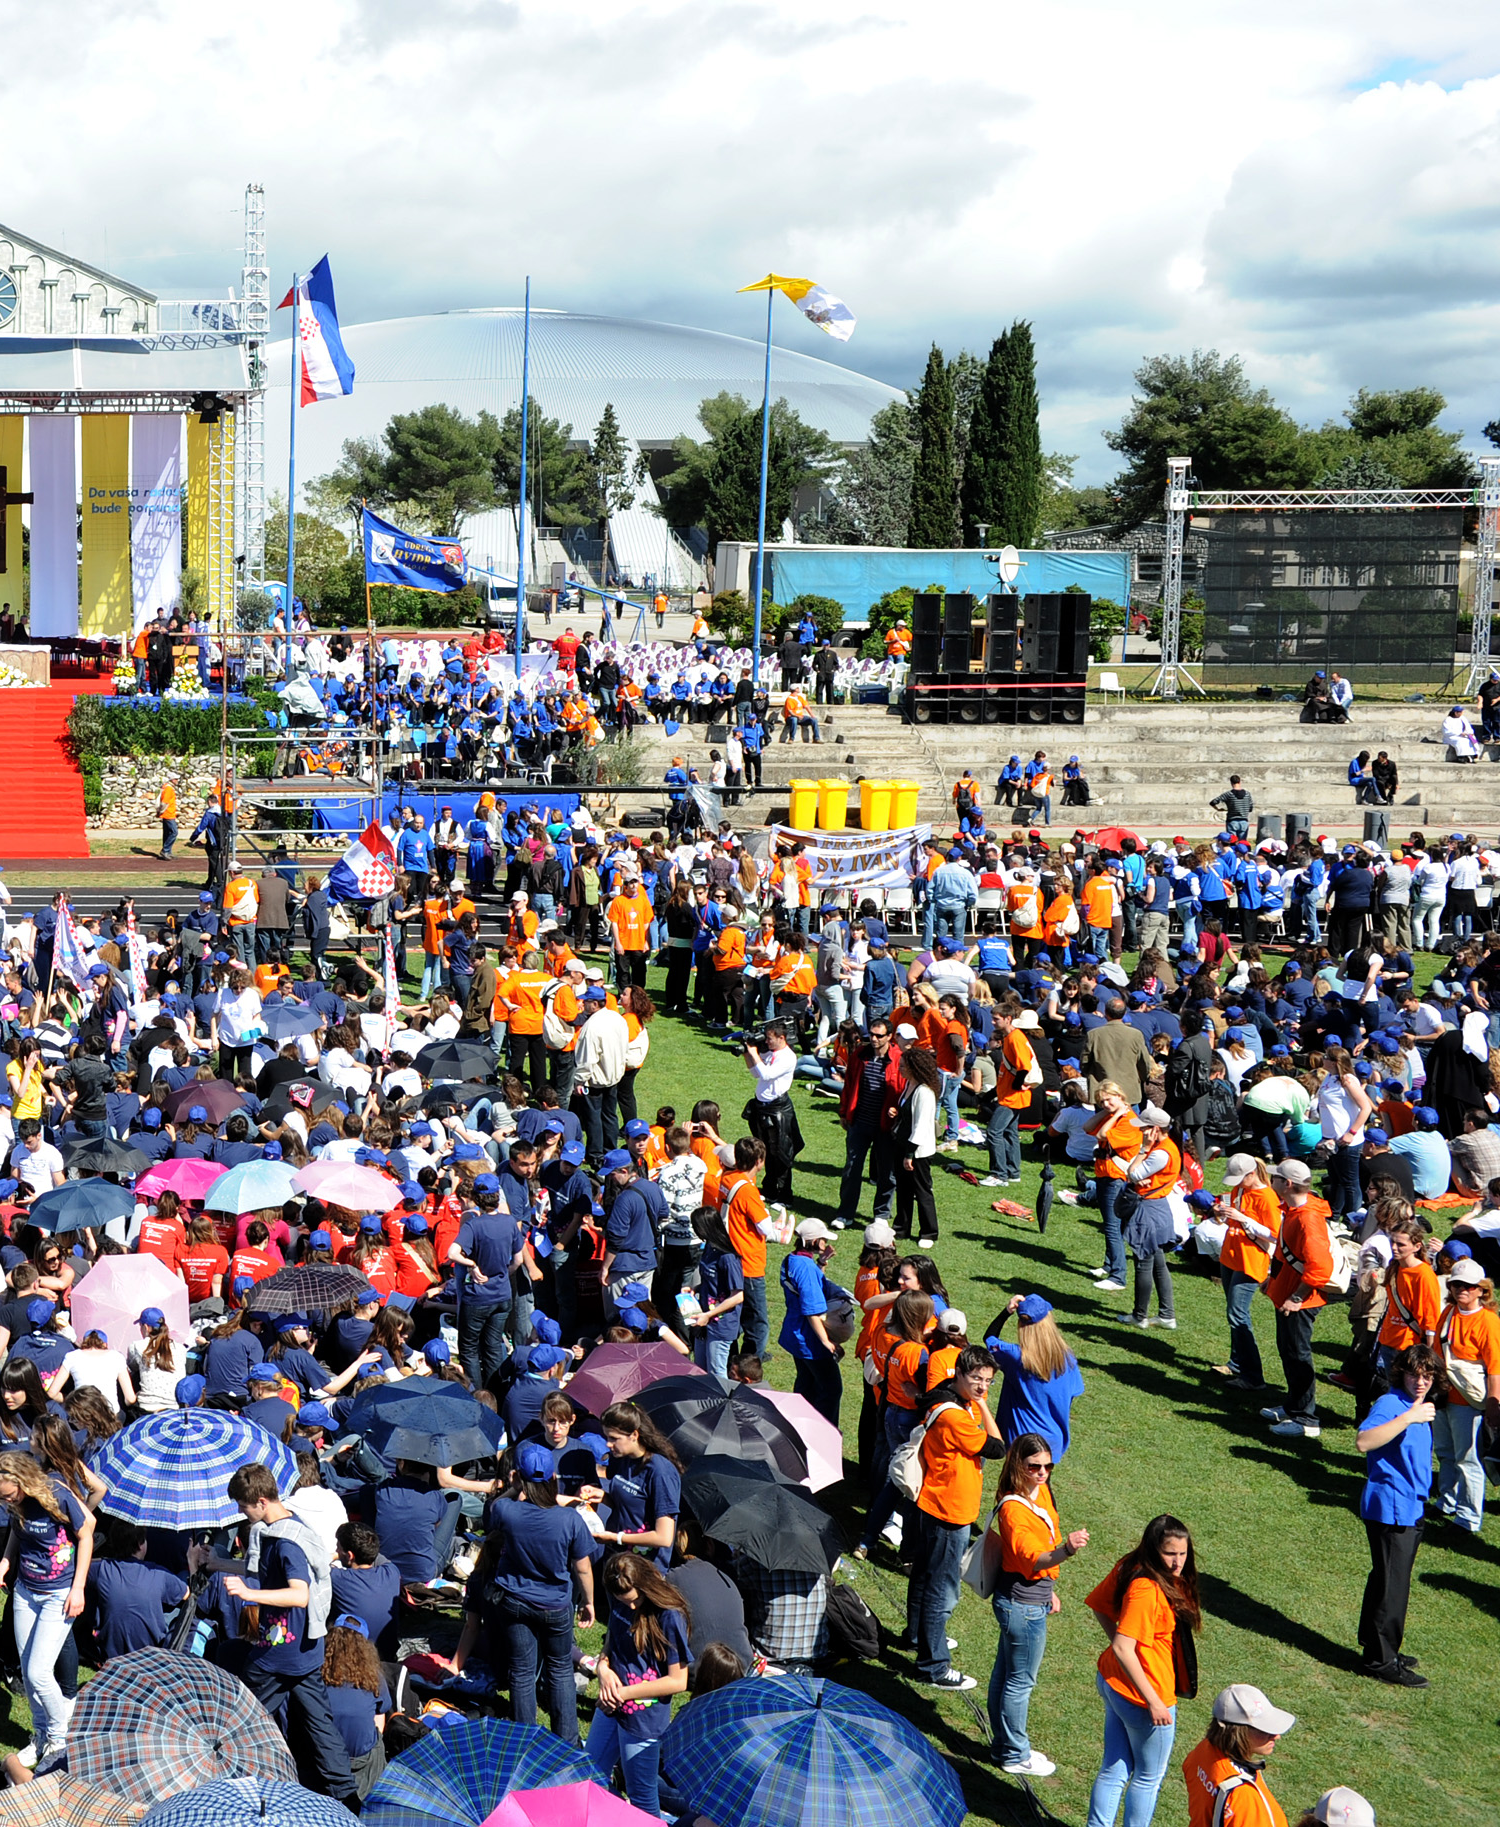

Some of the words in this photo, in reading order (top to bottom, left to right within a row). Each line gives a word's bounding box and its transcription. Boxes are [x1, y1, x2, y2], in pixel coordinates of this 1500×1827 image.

[88, 487, 106, 498] Da
[109, 485, 139, 498] vaša
[143, 485, 186, 498] radost
[91, 502, 122, 514] bude
[393, 548, 442, 566] HVIDR
[816, 856, 844, 873] SV.
[850, 851, 901, 872] IVAN
